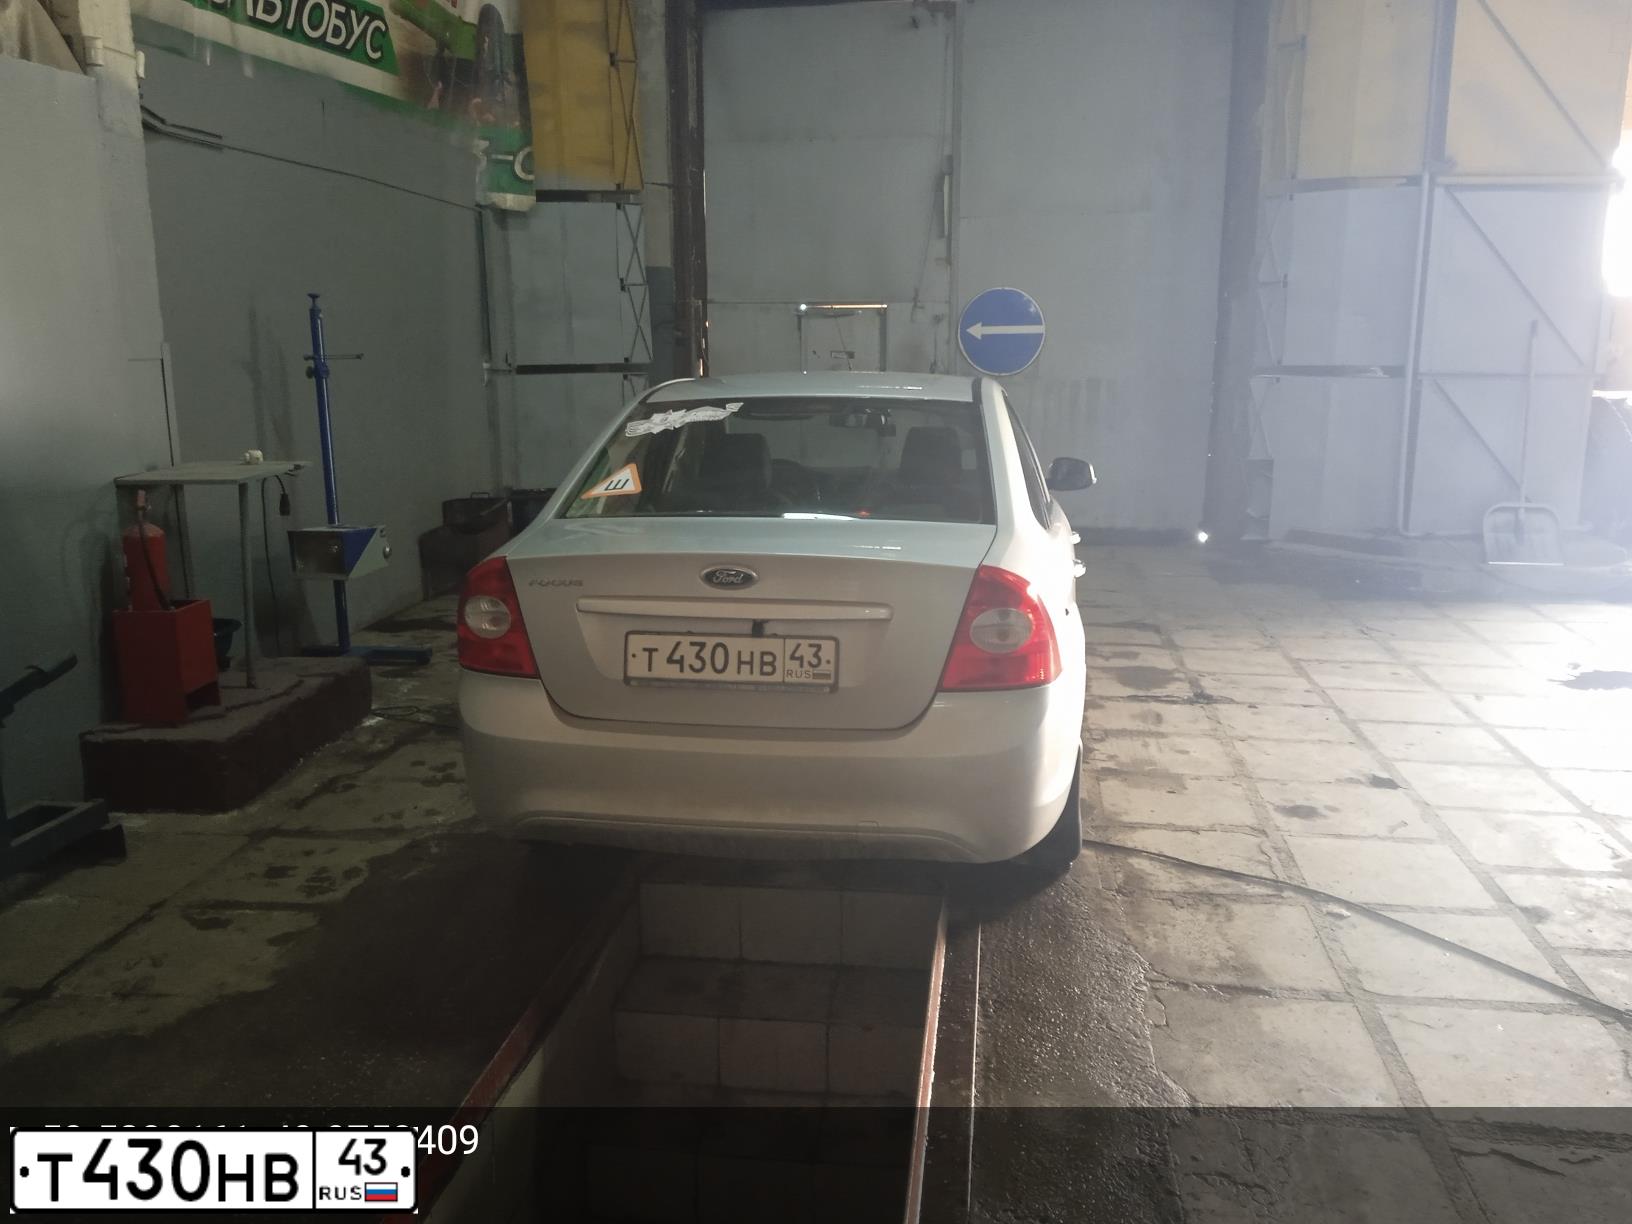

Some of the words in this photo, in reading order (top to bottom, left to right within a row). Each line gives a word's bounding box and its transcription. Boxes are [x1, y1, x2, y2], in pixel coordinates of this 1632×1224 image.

[604, 478, 630, 491] Ш
[712, 567, 745, 584] Ford
[789, 643, 822, 669] 43
[786, 669, 811, 679] RUS
